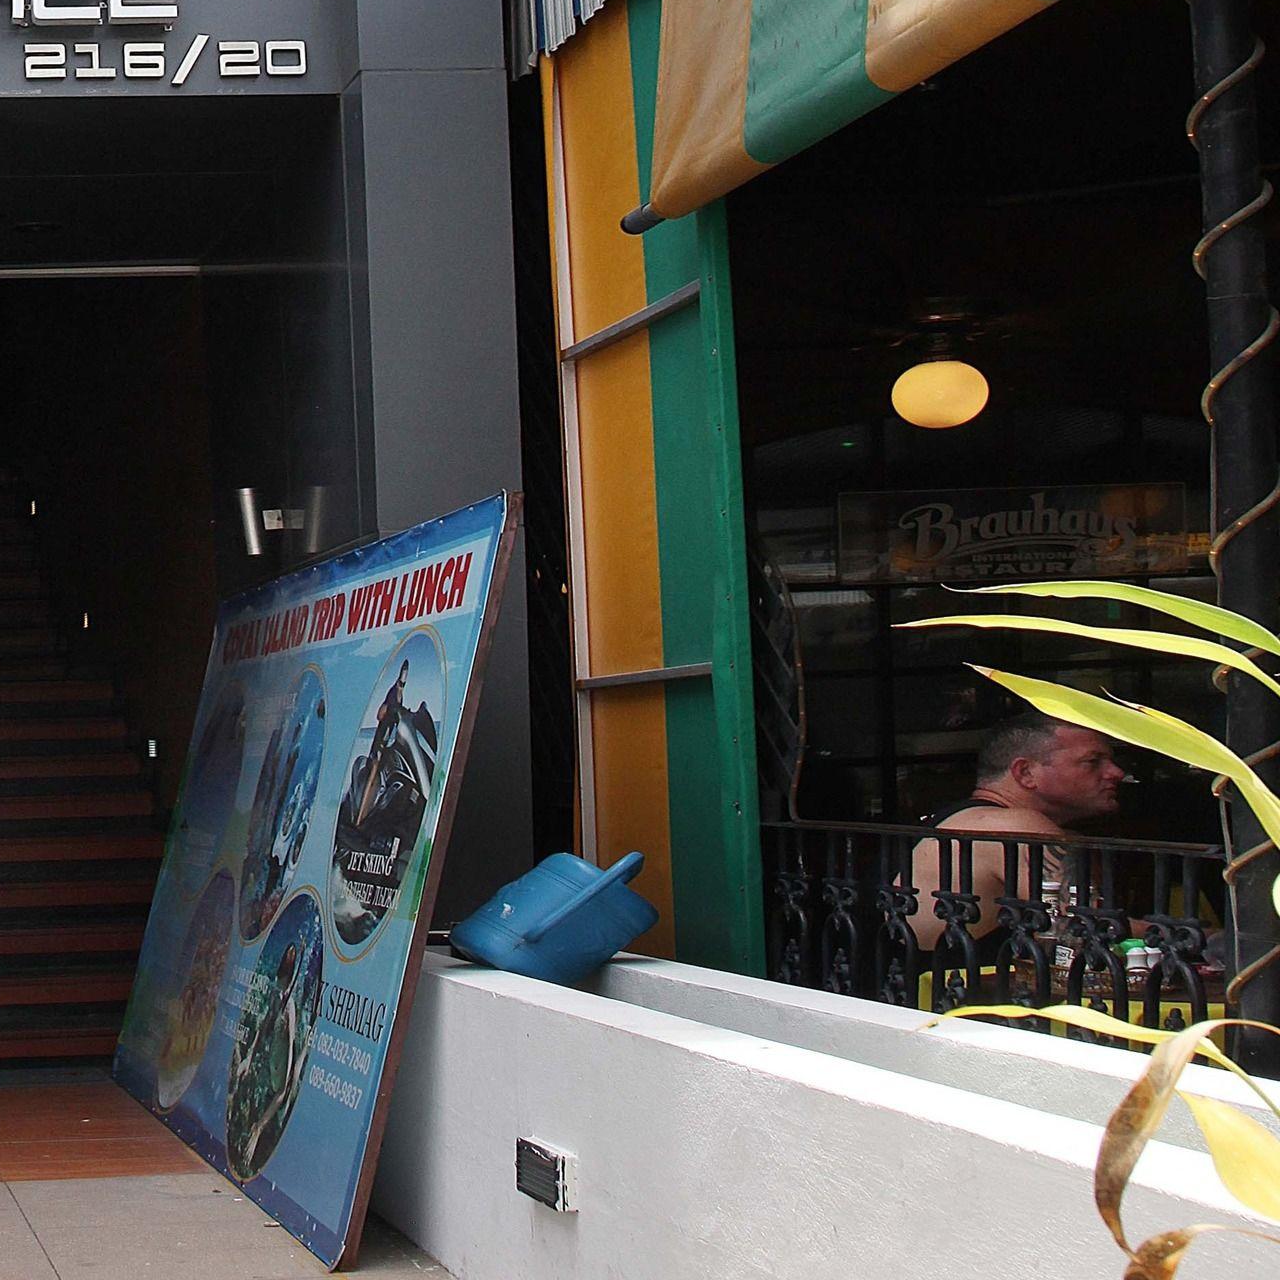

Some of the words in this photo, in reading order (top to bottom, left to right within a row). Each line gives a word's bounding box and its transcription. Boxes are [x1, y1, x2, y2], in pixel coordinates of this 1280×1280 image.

[23, 34, 309, 87] 216/20
[307, 591, 347, 643] TRIP
[347, 576, 398, 635] WITH
[394, 551, 474, 624] LUNCH
[347, 851, 366, 872] JET
